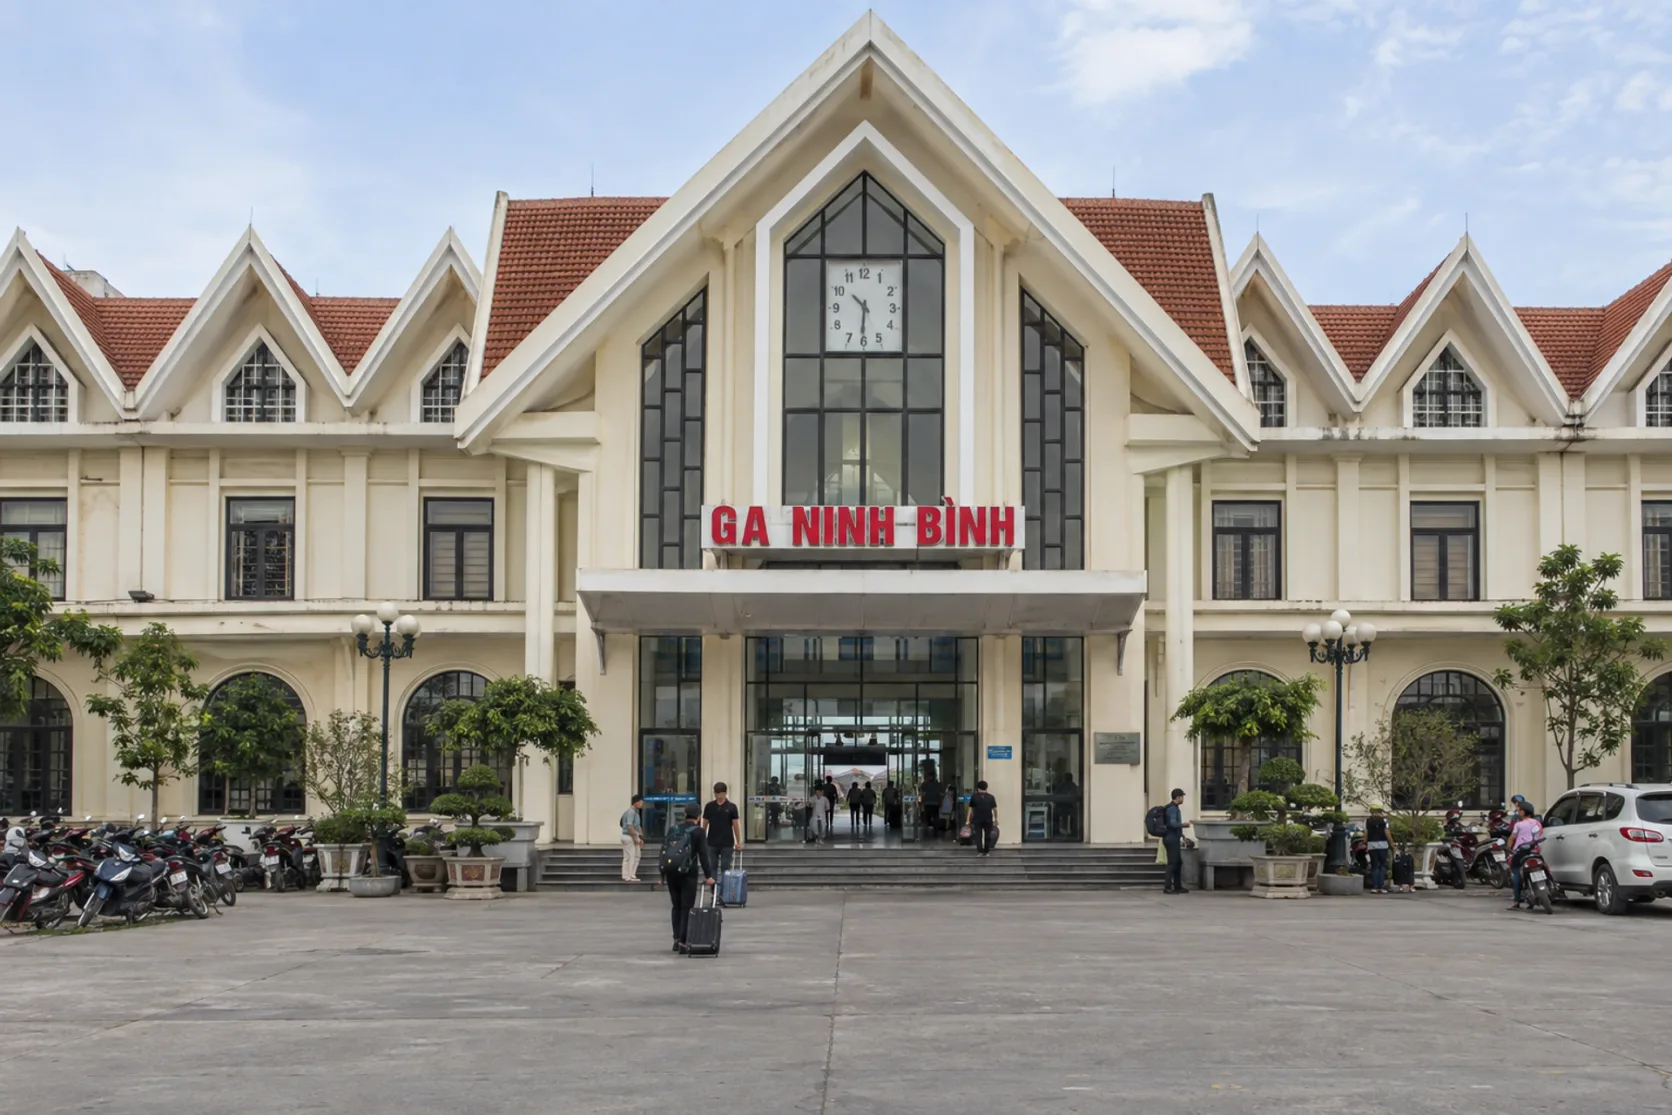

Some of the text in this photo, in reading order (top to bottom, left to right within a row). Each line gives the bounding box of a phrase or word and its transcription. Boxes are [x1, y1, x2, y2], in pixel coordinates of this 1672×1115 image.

[845, 272, 853, 284] 11
[859, 267, 870, 280] 12
[877, 272, 882, 284] 1
[834, 285, 845, 297] 10
[887, 285, 894, 297] 2
[832, 302, 840, 314] 9
[889, 302, 897, 314] 3
[834, 319, 841, 330] 8
[886, 320, 894, 330] 4
[845, 332, 853, 343] 7
[860, 335, 868, 347] 6
[875, 332, 883, 343] 5
[711, 496, 1015, 546] GA NINH BÌNH
